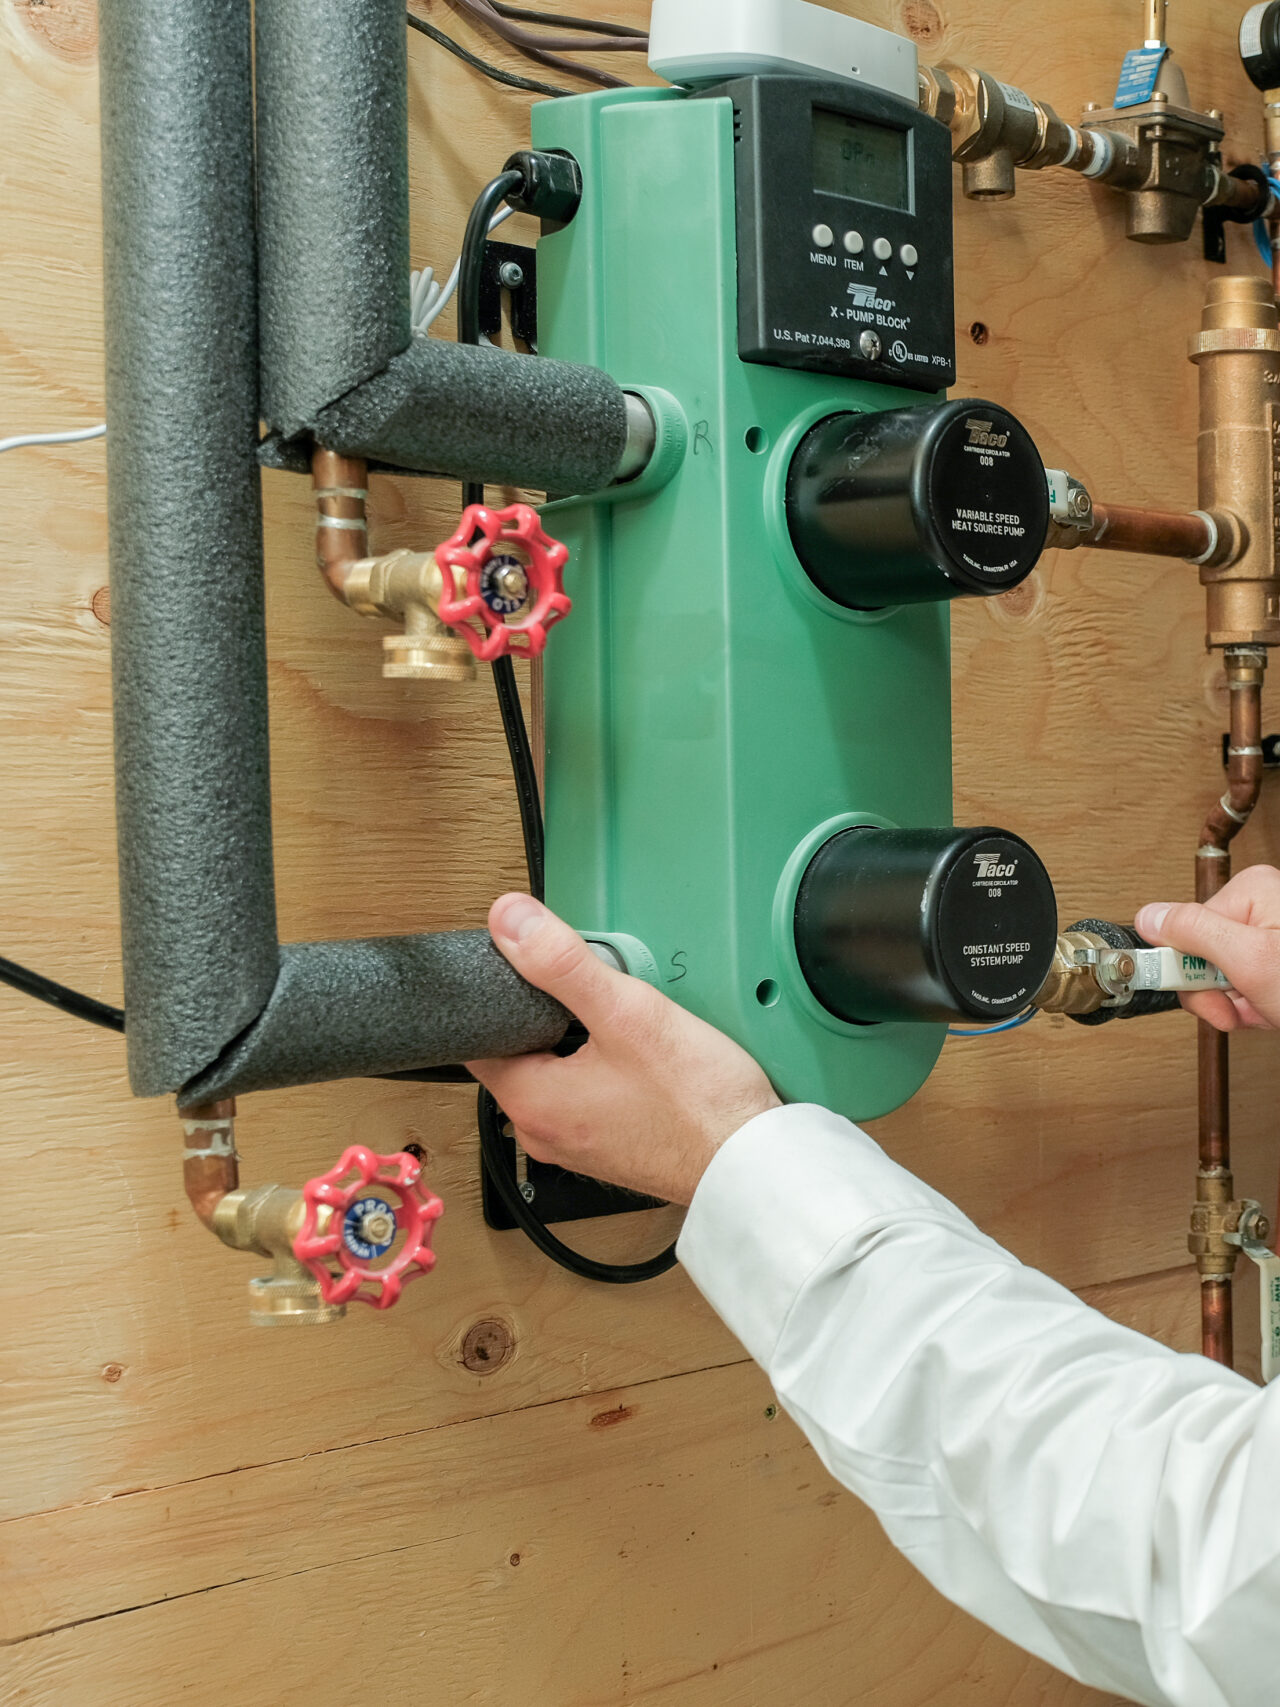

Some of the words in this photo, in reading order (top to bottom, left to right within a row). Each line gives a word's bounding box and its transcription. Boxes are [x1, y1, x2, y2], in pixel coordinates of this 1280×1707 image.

[809, 252, 837, 267] MENU
[844, 258, 864, 271] ITEM
[847, 282, 893, 311] Taco
[846, 309, 875, 323] PUMP
[773, 329, 793, 341] U.S.
[795, 331, 809, 343] Pat
[811, 334, 851, 349] 7,044,398
[693, 419, 714, 456] R
[980, 455, 994, 466] 008
[956, 508, 994, 522] VARIABLE
[995, 512, 1020, 525] SPEED
[951, 519, 972, 531] HEAT
[973, 523, 1003, 535] SOURCE
[1003, 526, 1025, 537] PUMP
[973, 853, 1015, 878] Taco
[988, 887, 1002, 898] 008
[963, 943, 1004, 955] CONSTANT
[1005, 942, 1031, 953] SPEED
[666, 950, 688, 983] S
[970, 956, 1001, 967] SYSTEM
[1001, 954, 1024, 965] PUMP
[1182, 955, 1207, 971] FNW
